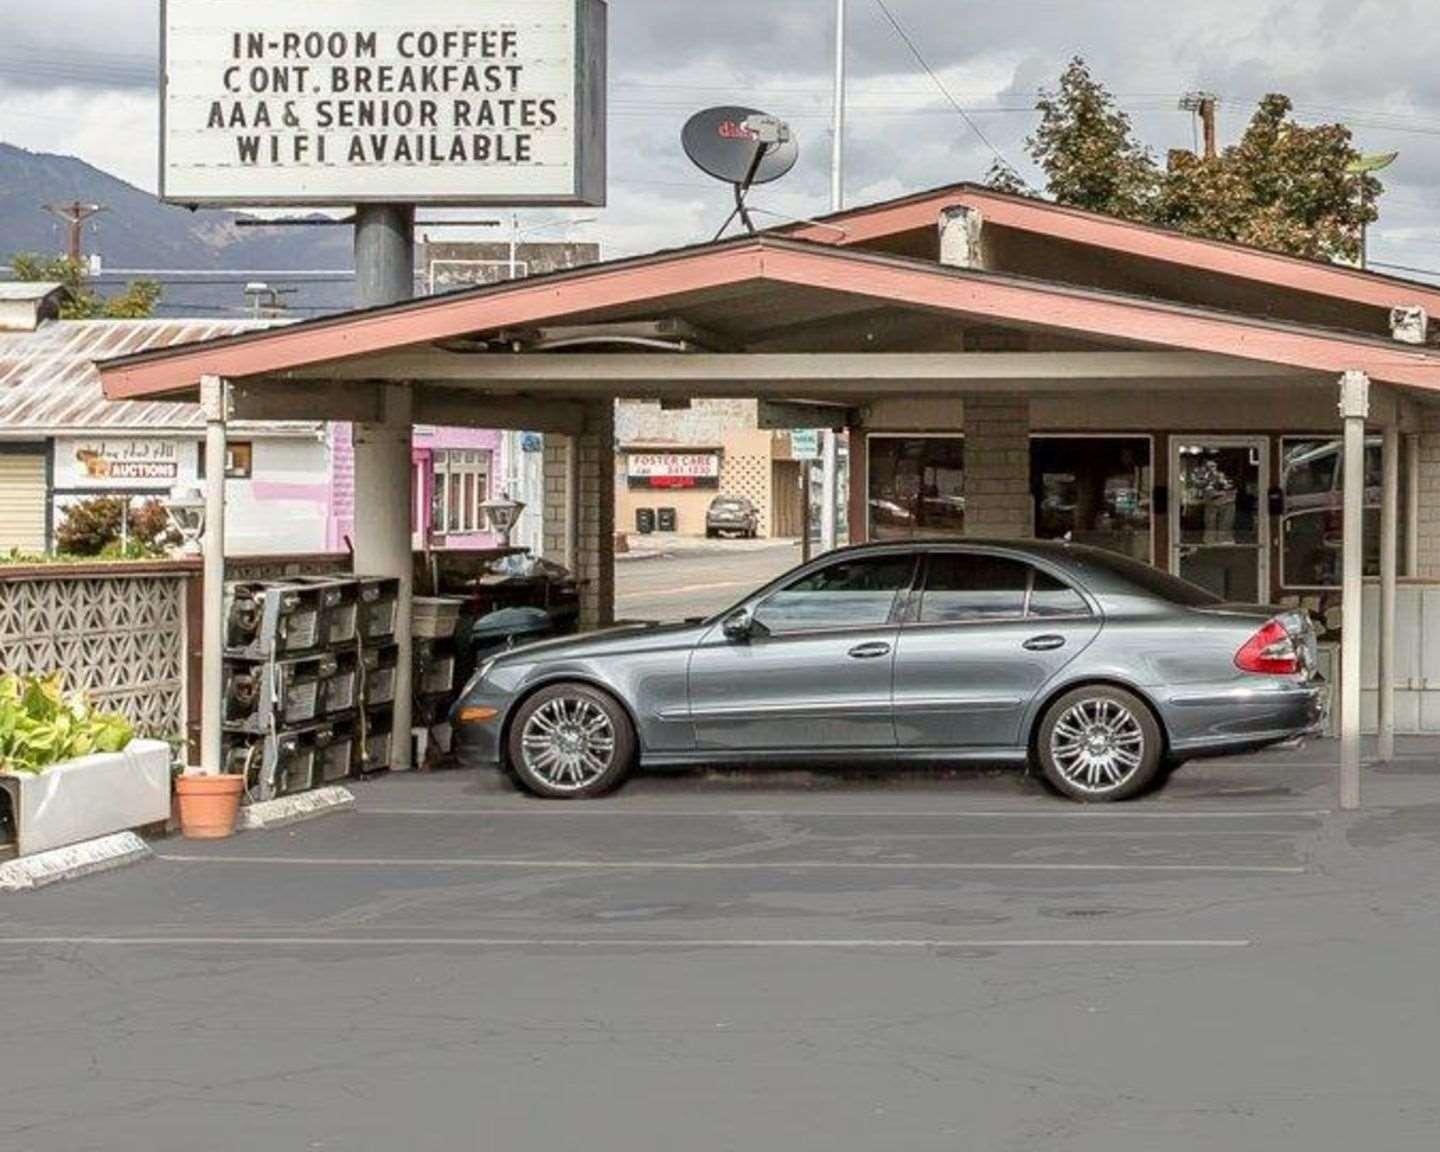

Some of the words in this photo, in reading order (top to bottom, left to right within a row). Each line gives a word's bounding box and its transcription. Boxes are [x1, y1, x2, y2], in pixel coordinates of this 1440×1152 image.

[232, 32, 377, 59] IN-ROOM
[398, 30, 519, 58] COFFEE
[224, 66, 321, 93] CONT.
[332, 66, 523, 93] BREAKFAST
[207, 100, 271, 128] AAA
[282, 101, 300, 127] &
[317, 100, 437, 128] SENIOR
[454, 99, 558, 127] RATES
[348, 134, 533, 163] AVAILABLE
[112, 463, 176, 477] AUCTIONS
[634, 455, 678, 466] FOSTER
[682, 455, 711, 466] CARE
